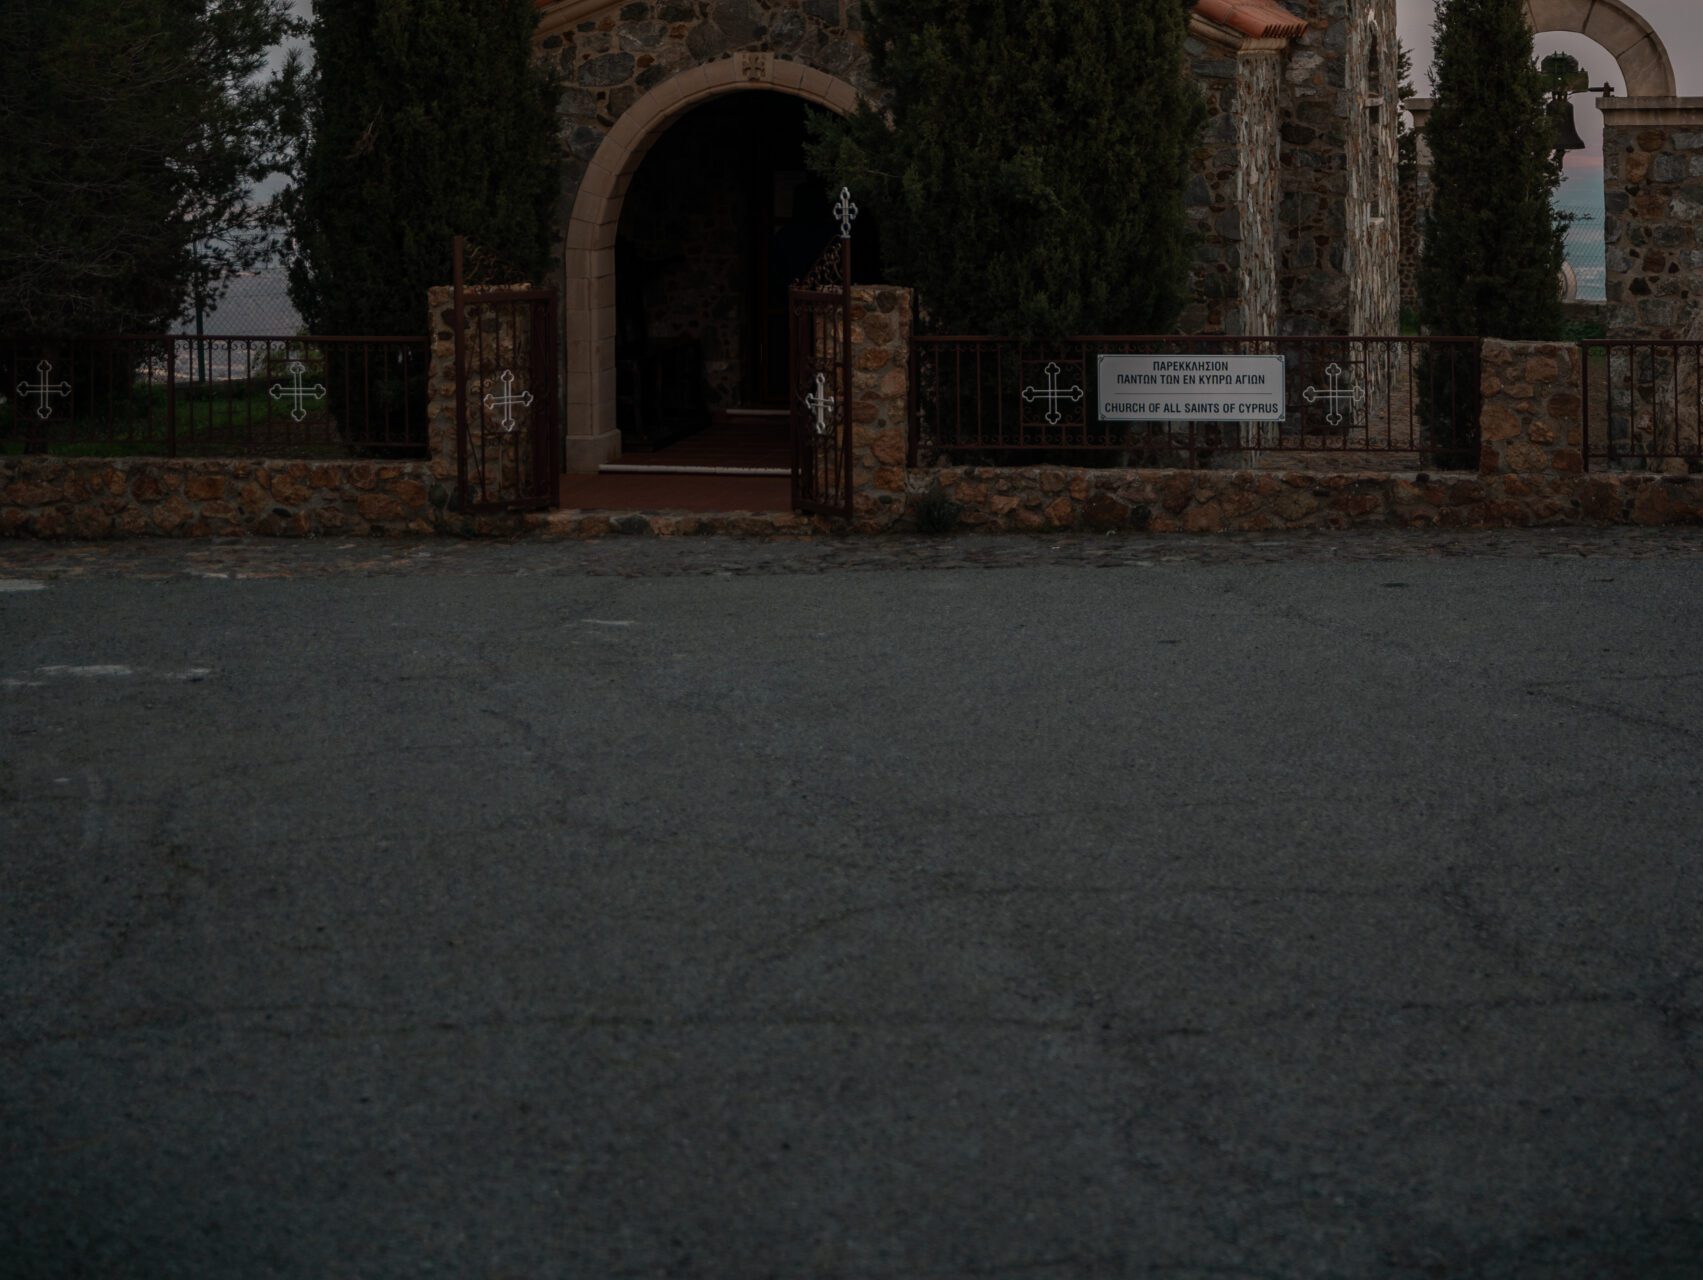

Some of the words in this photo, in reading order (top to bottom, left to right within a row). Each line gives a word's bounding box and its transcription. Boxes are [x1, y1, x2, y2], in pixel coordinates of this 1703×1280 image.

[1153, 361, 1228, 371] ΠΑΡΕΚΚΛΗΣΙΟΝ
[1117, 374, 1157, 384] ΠΑΝΤΩΝ
[1160, 374, 1180, 384] ΤΩΝ
[1183, 374, 1196, 384] ΕΝ
[1199, 374, 1232, 384] ΚΥΠΡΩ
[1235, 374, 1265, 384] ΑΓΙΩΝ
[1105, 402, 1145, 413] CHURCH
[1149, 402, 1160, 413] OF
[1163, 402, 1181, 413] ALL
[1185, 403, 1219, 413] SAINTS
[1223, 403, 1236, 413] OF
[1239, 403, 1278, 413] CYPRUS
